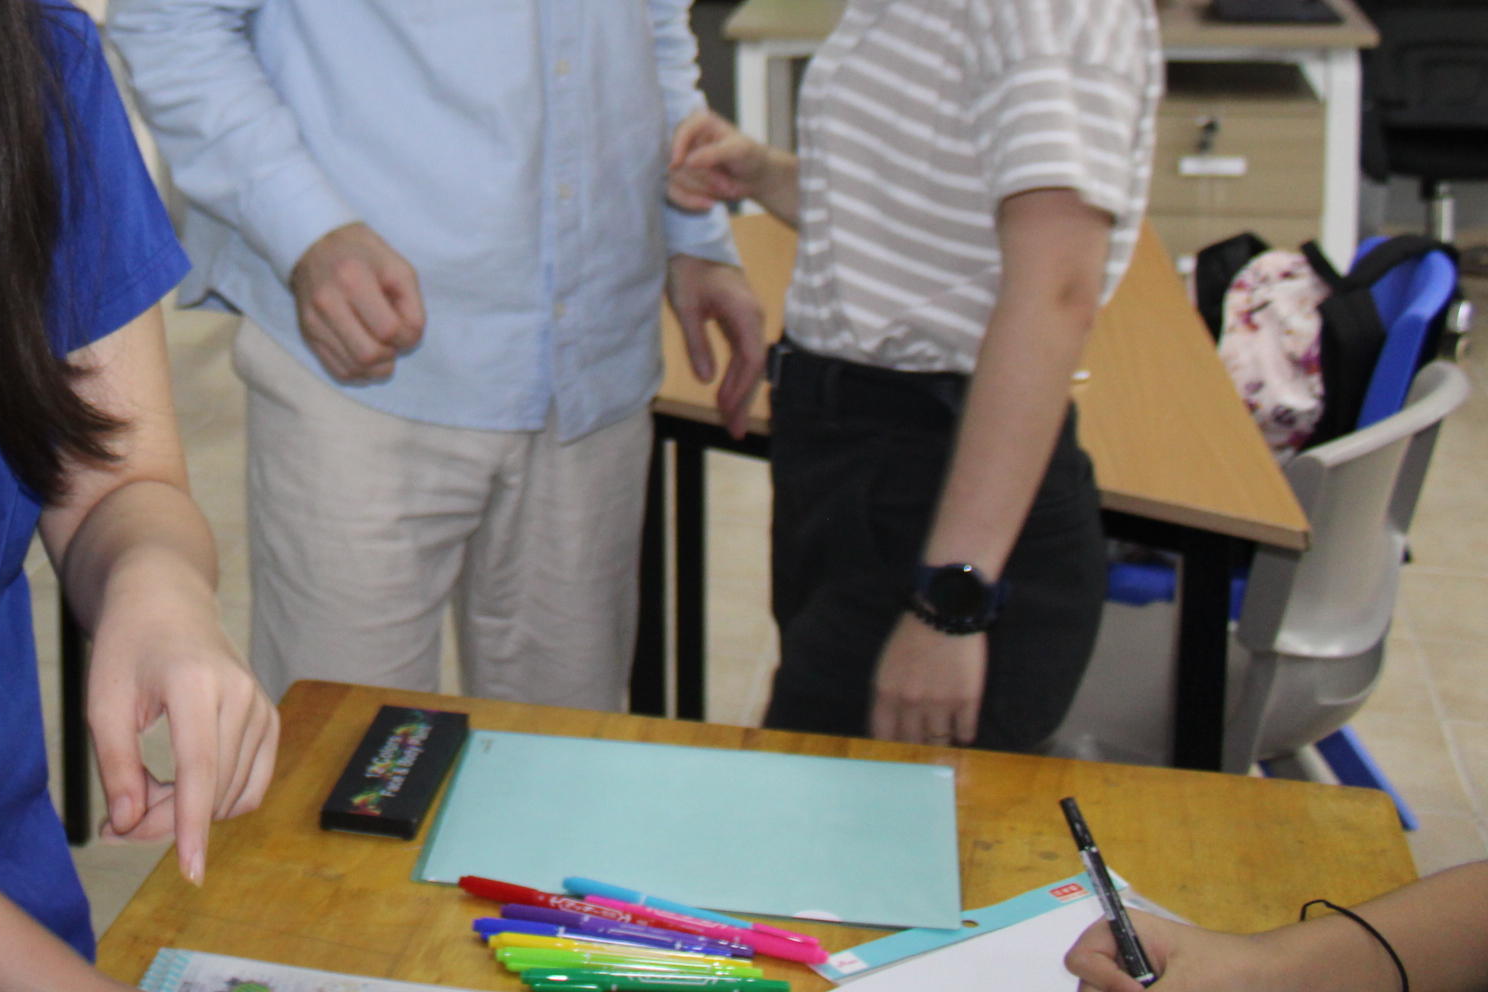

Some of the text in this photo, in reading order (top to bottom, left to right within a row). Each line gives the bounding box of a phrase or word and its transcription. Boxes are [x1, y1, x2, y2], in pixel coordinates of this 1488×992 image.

[372, 735, 402, 763] Colors
[380, 776, 405, 796] Face
[396, 747, 424, 766] Body
